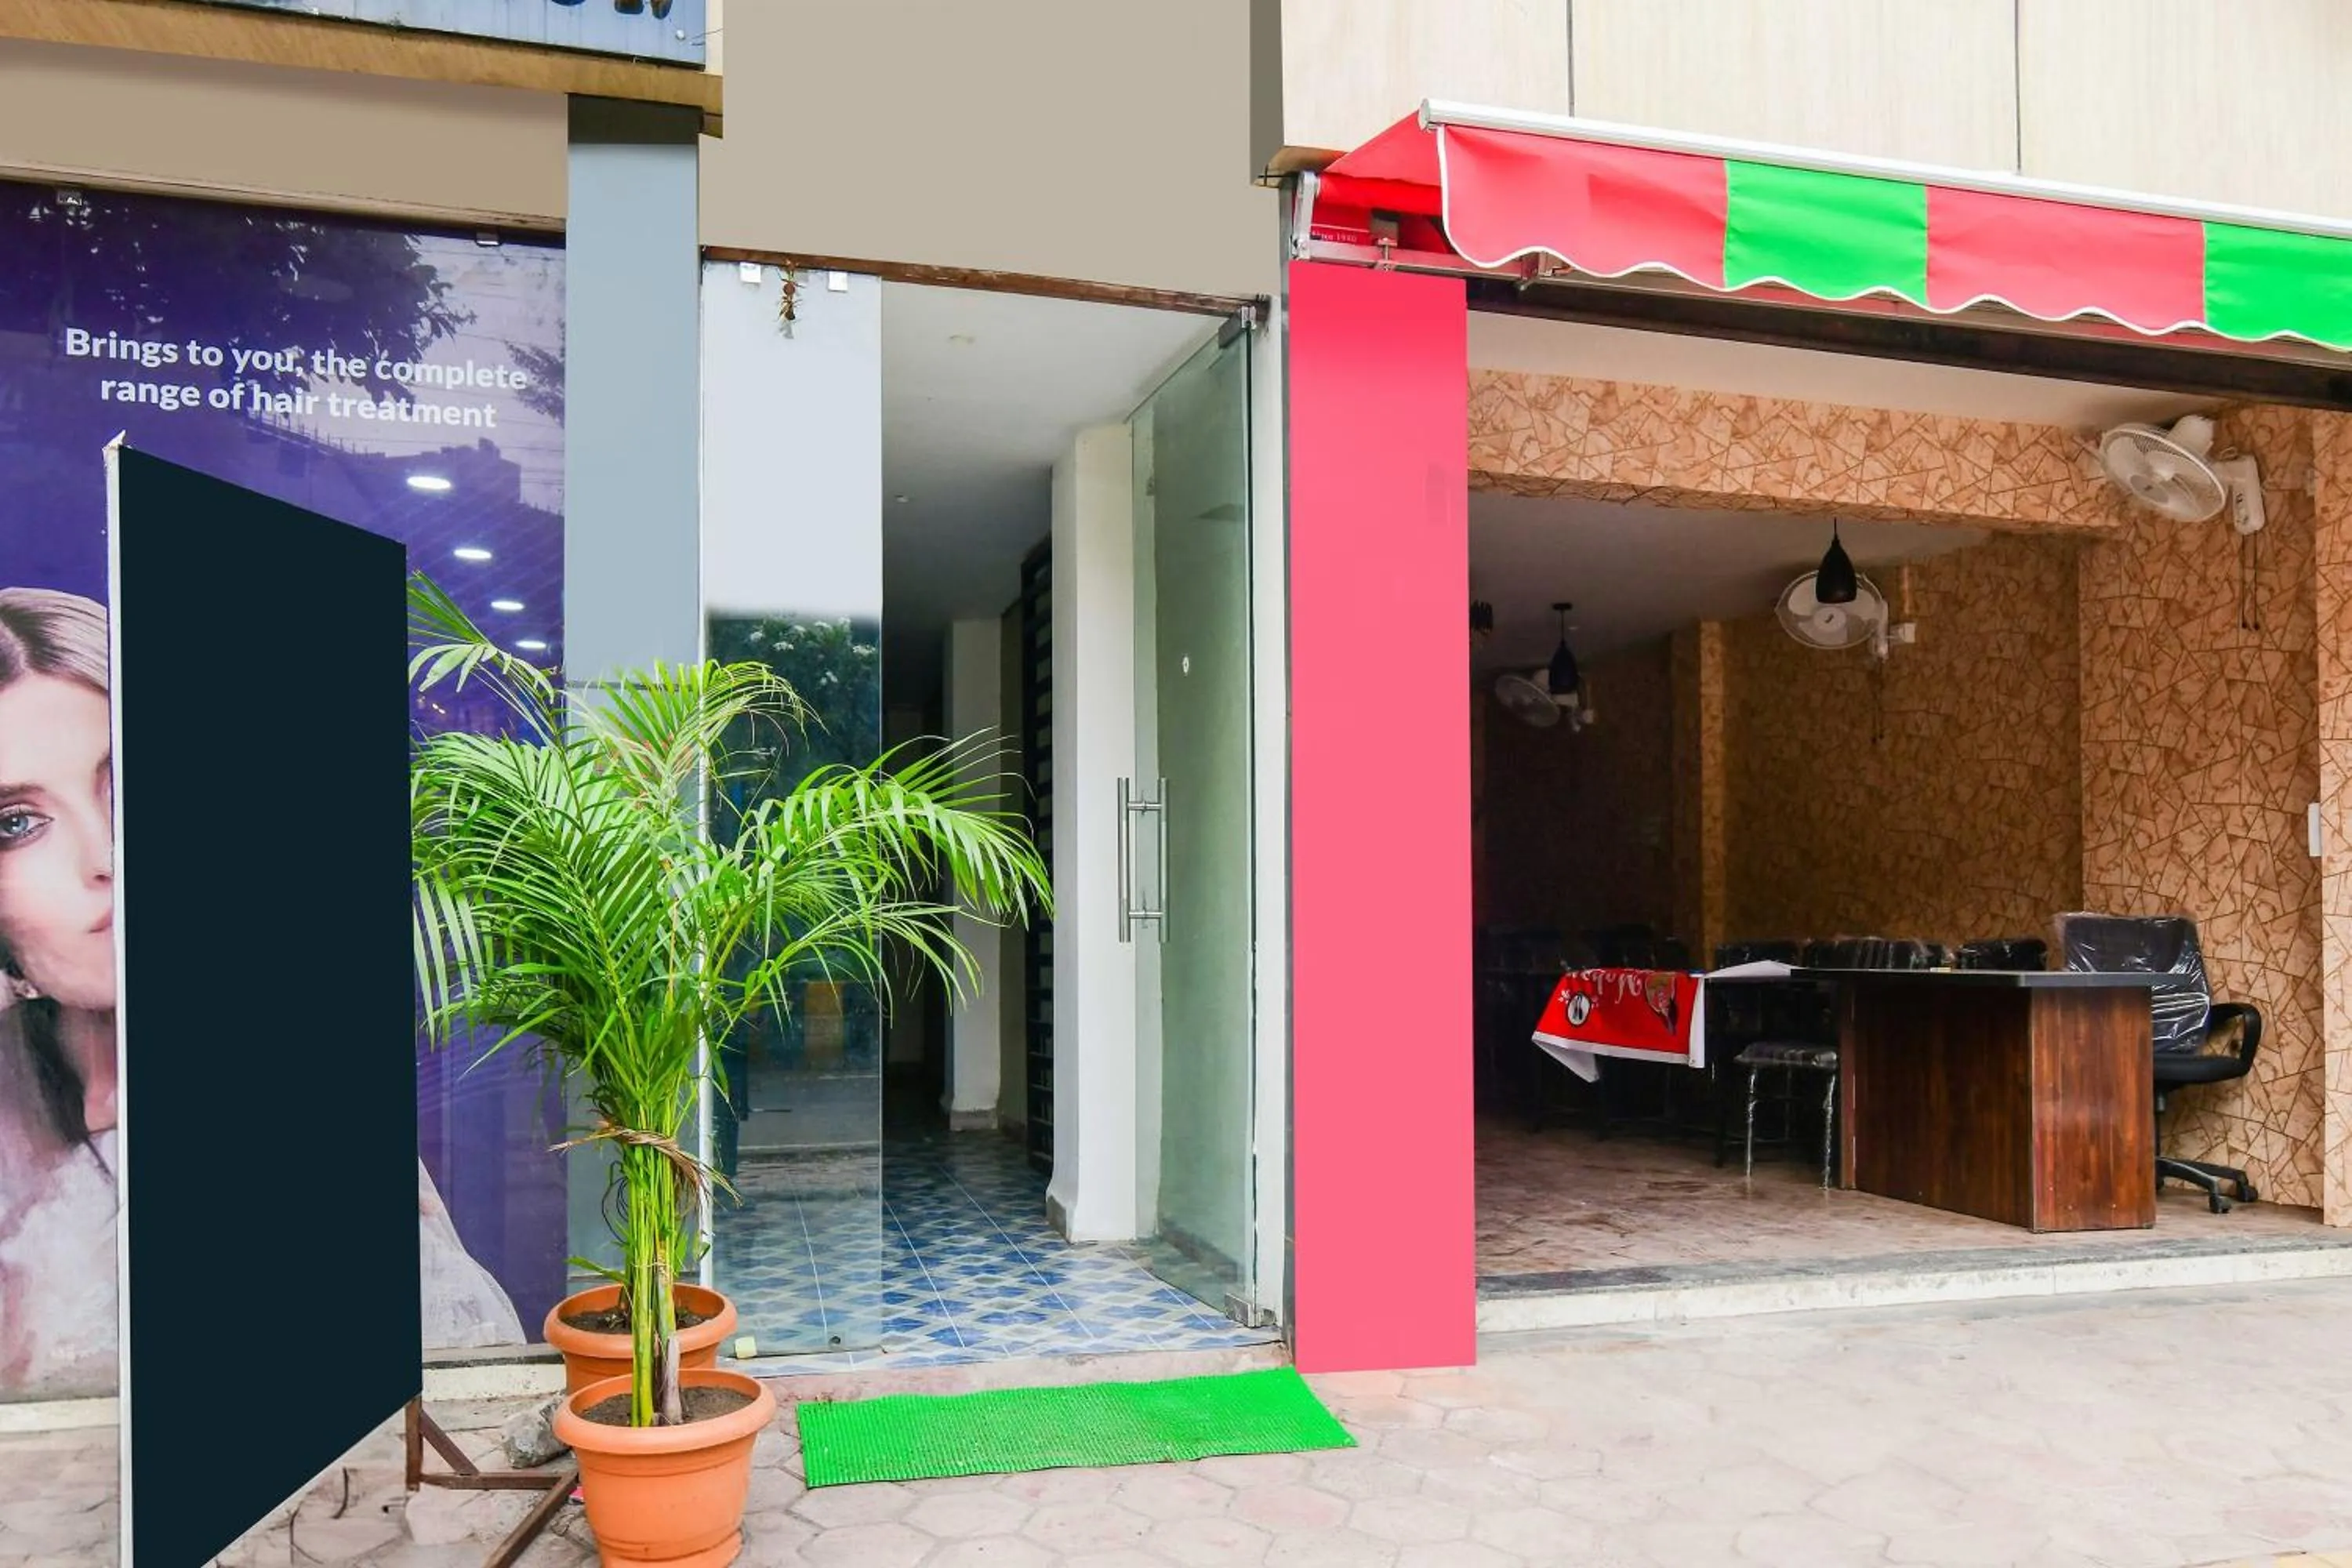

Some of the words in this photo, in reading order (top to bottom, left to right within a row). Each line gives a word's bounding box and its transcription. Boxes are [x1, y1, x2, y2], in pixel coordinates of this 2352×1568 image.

[66, 327, 179, 368] Brings
[186, 339, 223, 366] to
[231, 346, 303, 377] you,
[311, 348, 367, 378] the
[375, 359, 528, 390] complete
[101, 379, 200, 411] range
[208, 382, 245, 410] of
[253, 383, 319, 416] hair
[327, 393, 498, 428] treatment
